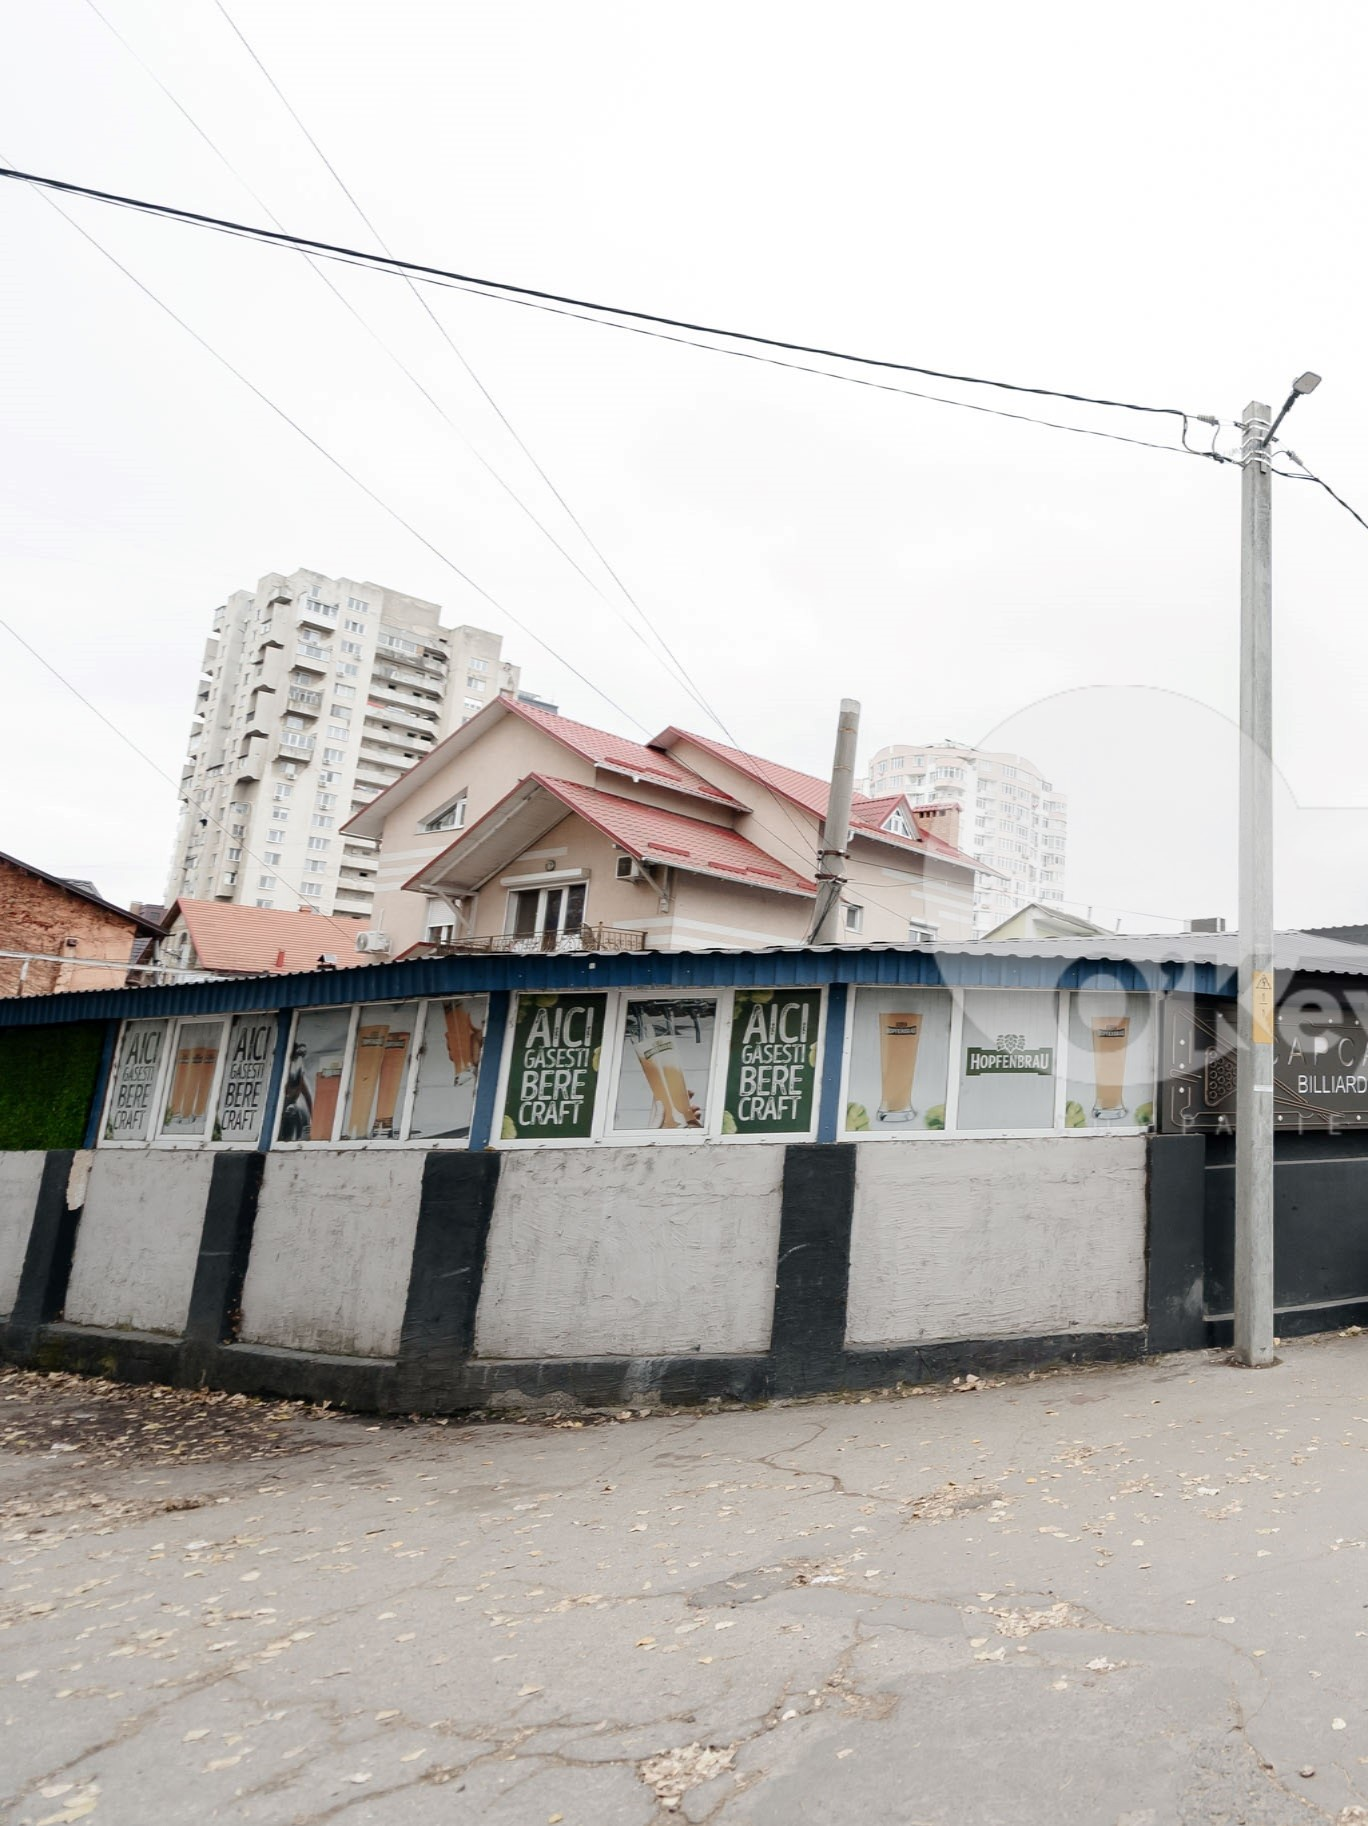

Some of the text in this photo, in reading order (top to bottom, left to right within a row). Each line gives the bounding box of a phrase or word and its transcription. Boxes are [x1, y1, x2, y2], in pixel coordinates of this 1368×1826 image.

[525, 1007, 594, 1048] AICI
[737, 1003, 809, 1044] AICI
[126, 1031, 161, 1064] AICI
[233, 1026, 271, 1061] AICI
[970, 1053, 1050, 1070] HOPFENBRAU
[520, 1069, 588, 1101] BERE
[739, 1065, 804, 1097] BERE
[1298, 1074, 1368, 1094] BILLIARD
[117, 1083, 151, 1109] BERE
[225, 1081, 262, 1108] BERE
[113, 1110, 145, 1130] CRAFT
[221, 1110, 257, 1131] CRAFT
[518, 1100, 584, 1126] CRAFT
[738, 1096, 802, 1122] CRAFT
